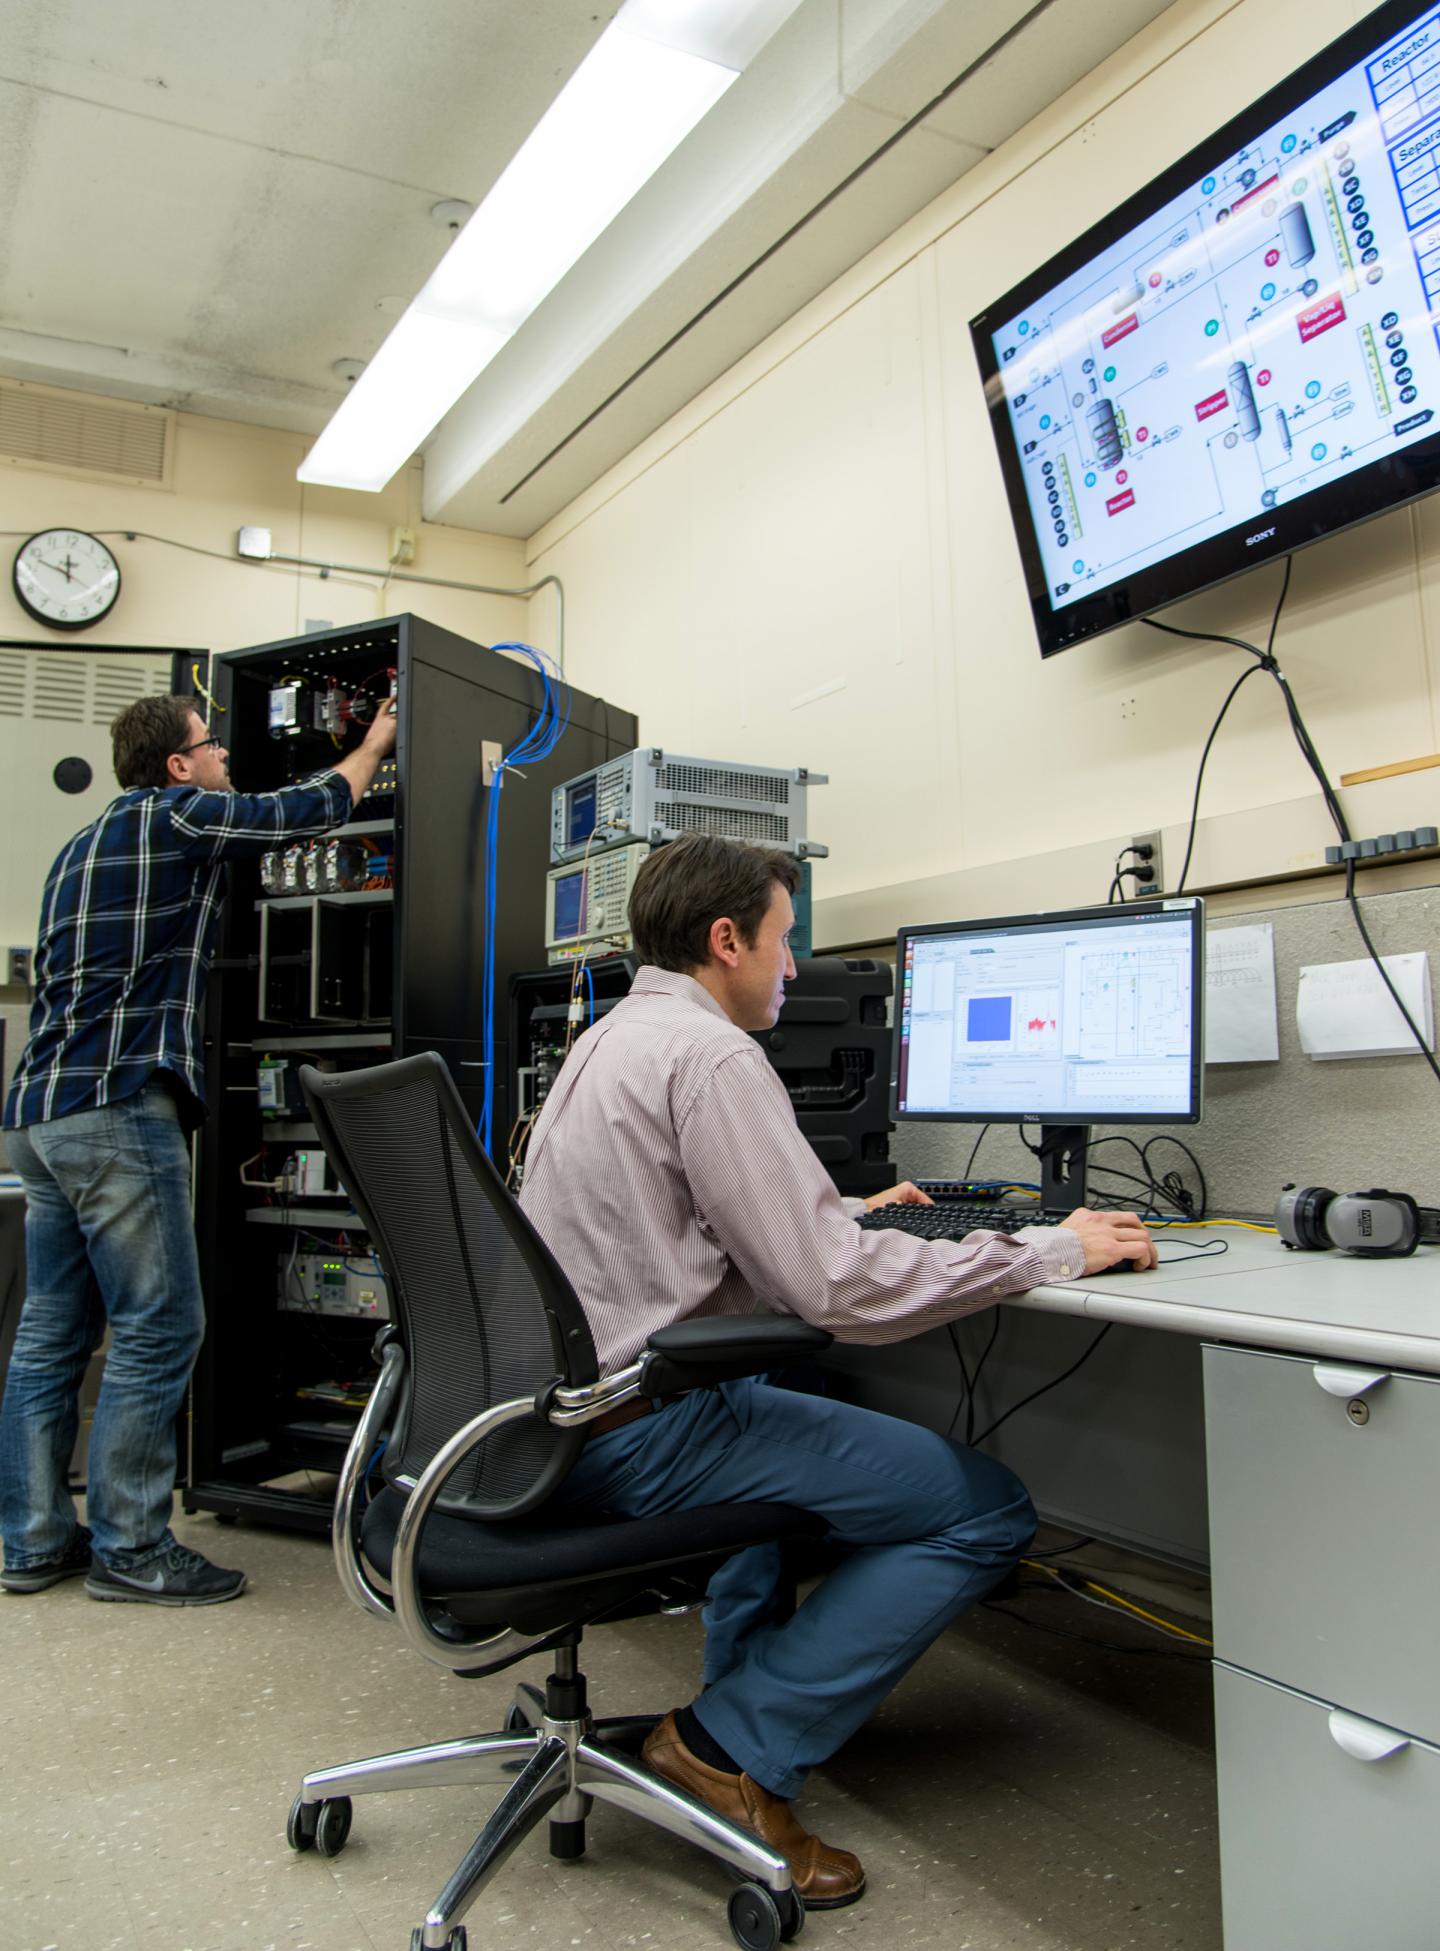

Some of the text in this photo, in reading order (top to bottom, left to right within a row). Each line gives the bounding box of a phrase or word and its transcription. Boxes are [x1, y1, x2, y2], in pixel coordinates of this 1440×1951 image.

[1382, 33, 1429, 72] Reactor
[1323, 118, 1345, 139] Purge
[1301, 307, 1342, 337] Separator
[1396, 412, 1427, 433] Product
[48, 537, 56, 549] 11
[67, 535, 79, 546] 12
[1245, 527, 1277, 546] SONY
[31, 547, 42, 558] 10
